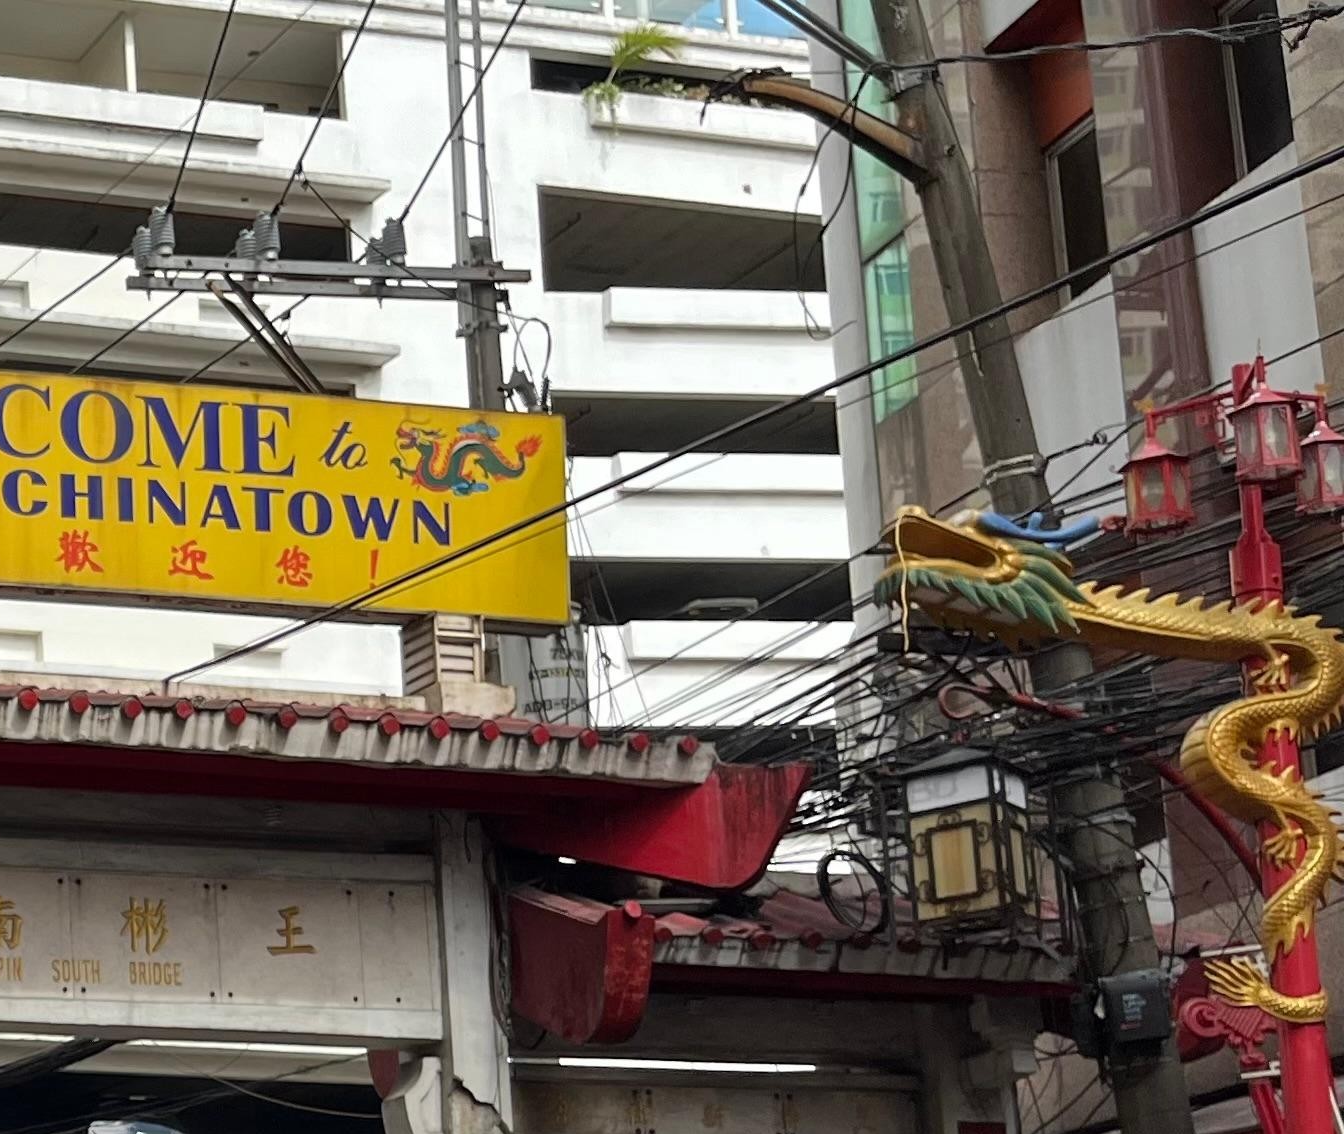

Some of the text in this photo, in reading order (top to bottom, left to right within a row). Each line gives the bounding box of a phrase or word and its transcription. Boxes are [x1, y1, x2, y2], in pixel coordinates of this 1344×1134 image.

[318, 420, 368, 469] to
[2, 468, 452, 546] CHINATOWN
[51, 958, 102, 985] SOUTH
[128, 960, 183, 987] BRIDGE
